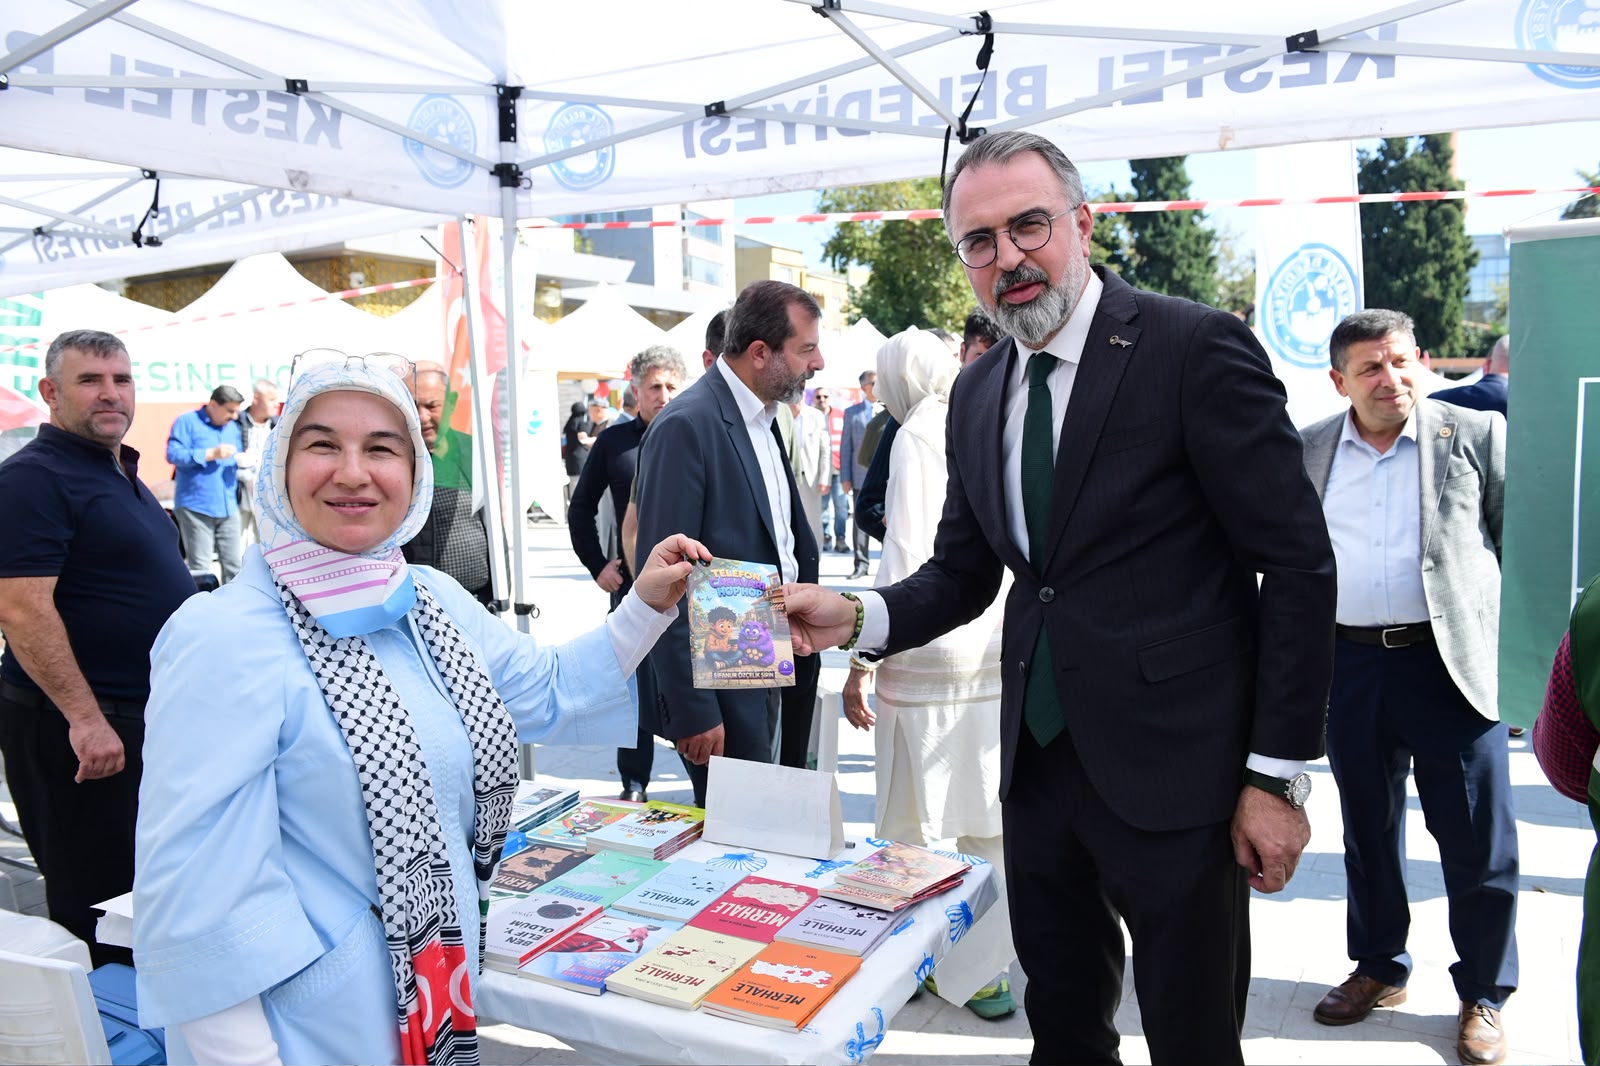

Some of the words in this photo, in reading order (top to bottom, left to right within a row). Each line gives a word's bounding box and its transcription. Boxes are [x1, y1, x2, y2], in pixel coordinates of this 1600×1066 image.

[132, 361, 235, 392] ESİNE
[711, 568, 761, 580] TELEFON
[494, 874, 539, 890] MERH
[545, 885, 603, 903] MERHALE
[638, 889, 700, 908] MERHALE
[710, 901, 790, 928] MERHALE
[514, 931, 543, 941] ELİF
[799, 919, 868, 937] MERHALE
[505, 936, 534, 947] BEN
[634, 964, 706, 987] MERHALE
[731, 982, 807, 1006] MERHALE
